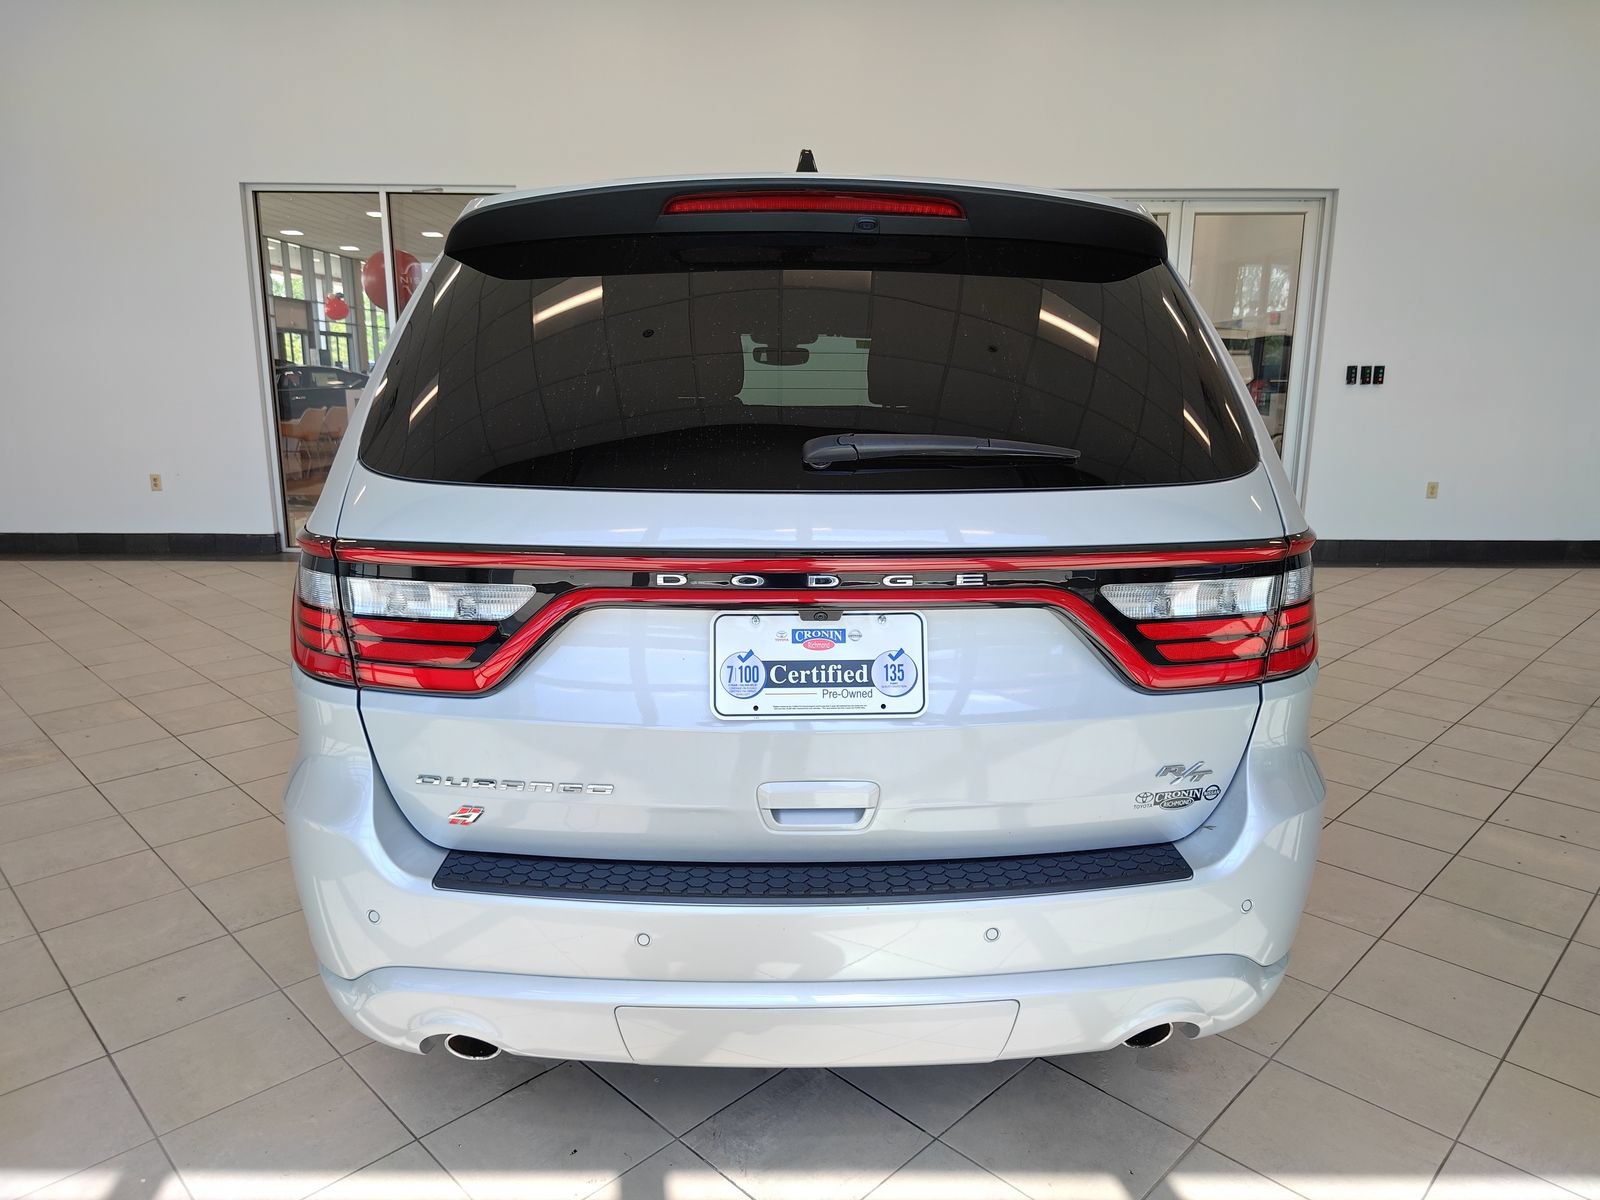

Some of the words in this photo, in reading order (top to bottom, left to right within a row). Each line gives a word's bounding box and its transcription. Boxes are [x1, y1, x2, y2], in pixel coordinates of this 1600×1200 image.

[656, 573, 985, 587] DODGE
[795, 630, 842, 642] CRONIN
[769, 664, 869, 684] Certified
[883, 663, 905, 682] 135
[822, 688, 873, 699] Pre-Owned
[415, 774, 614, 795] DURANGO
[1155, 788, 1203, 803] CRONIN
